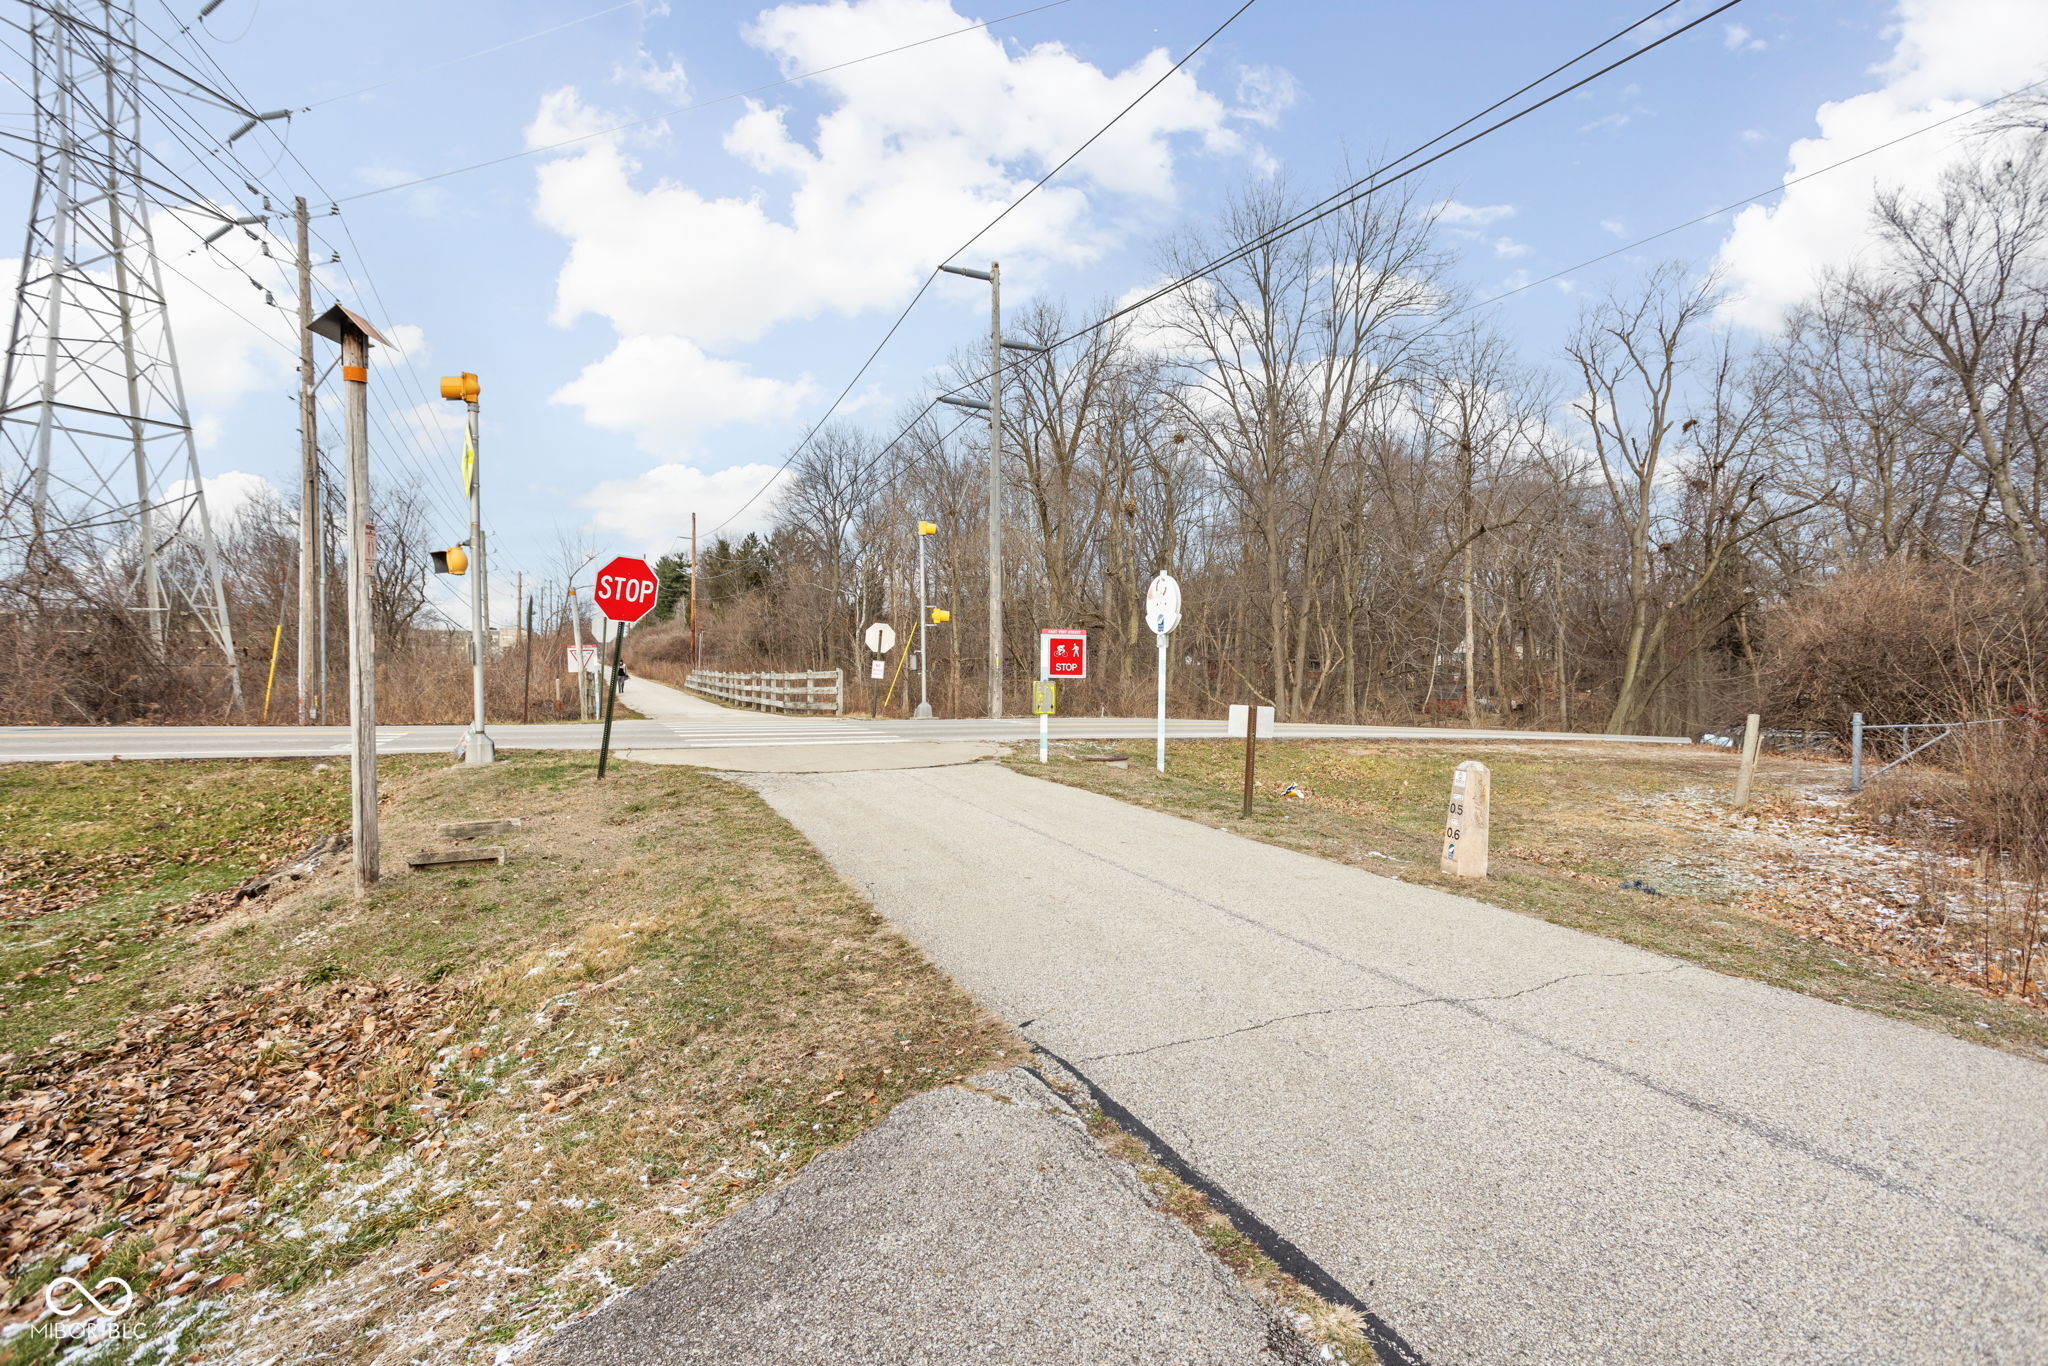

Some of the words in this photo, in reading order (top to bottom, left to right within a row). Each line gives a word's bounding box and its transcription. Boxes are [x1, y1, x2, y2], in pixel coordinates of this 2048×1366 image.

[598, 575, 654, 603] STOP
[1055, 663, 1078, 671] STOP
[1450, 803, 1463, 815] 0.5
[1447, 827, 1460, 840] 0.6
